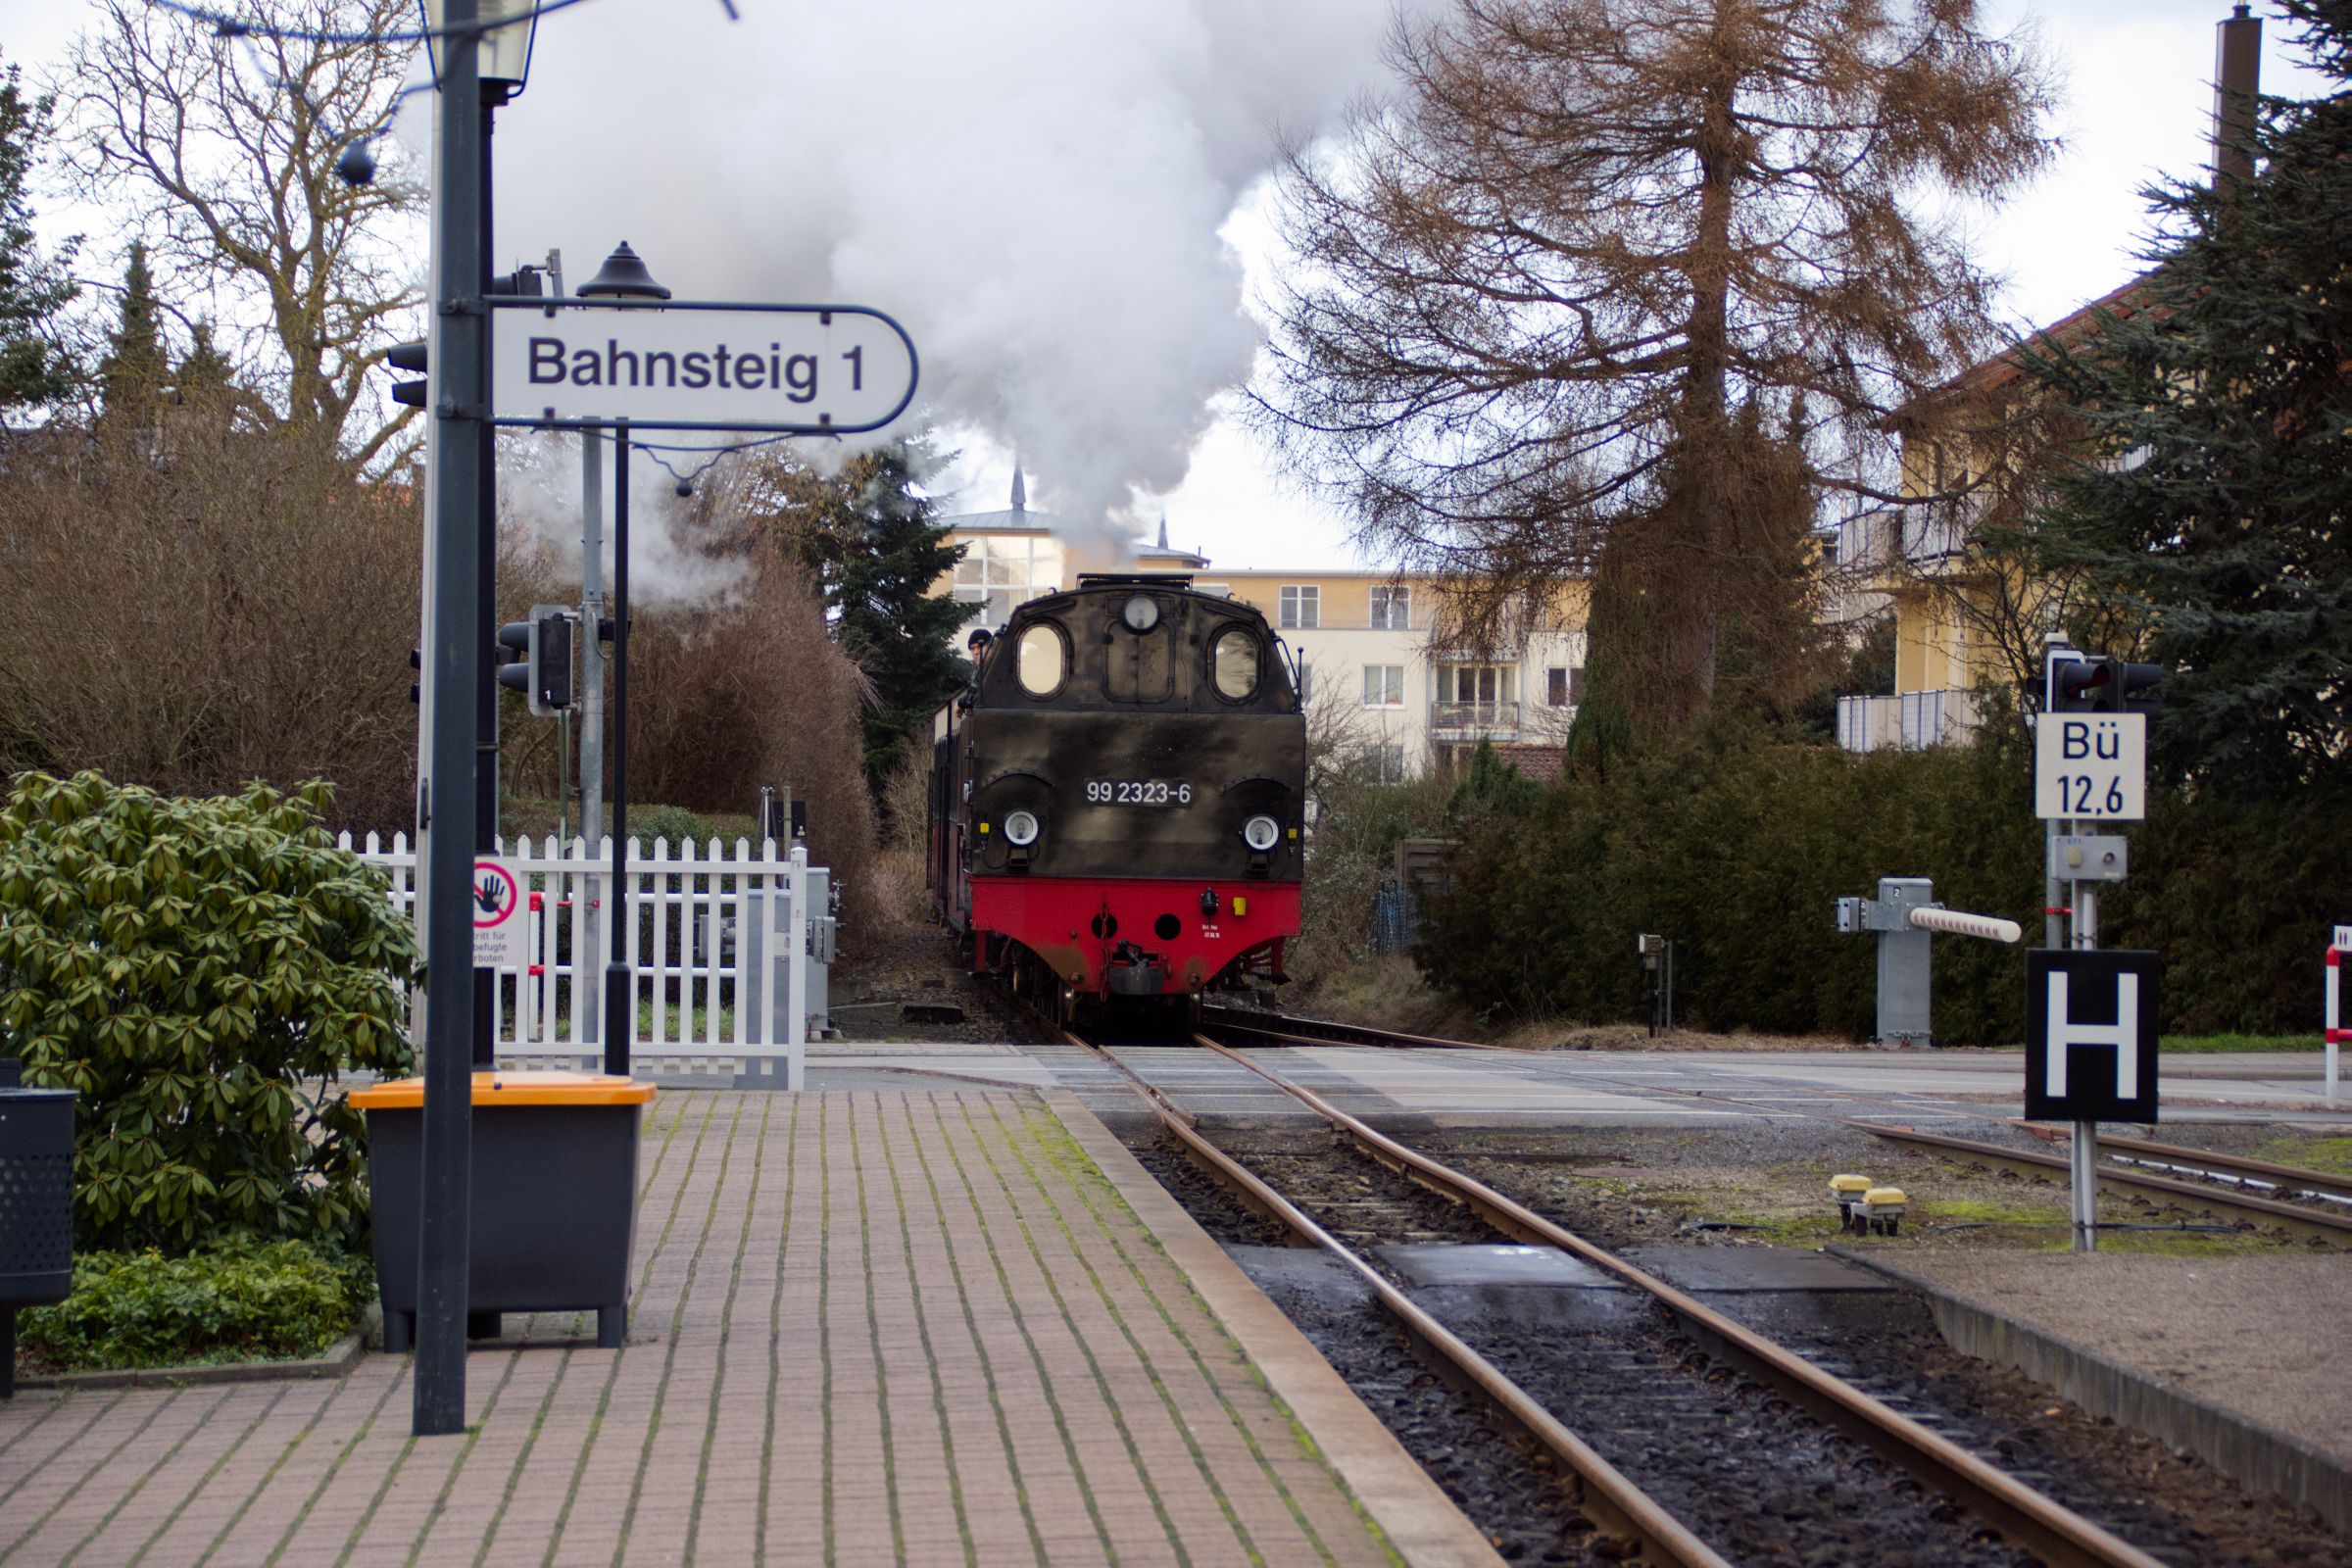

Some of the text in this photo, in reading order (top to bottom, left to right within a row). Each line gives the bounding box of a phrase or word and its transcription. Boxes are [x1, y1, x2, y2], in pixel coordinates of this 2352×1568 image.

[528, 336, 862, 404] Bahnsteig 1
[545, 689, 551, 700] 1
[2062, 721, 2120, 760] Bü
[1087, 781, 1191, 804] 99 2323-6
[2057, 775, 2124, 815] 12,6
[1893, 887, 1900, 898] 2
[2046, 971, 2138, 1100] H
